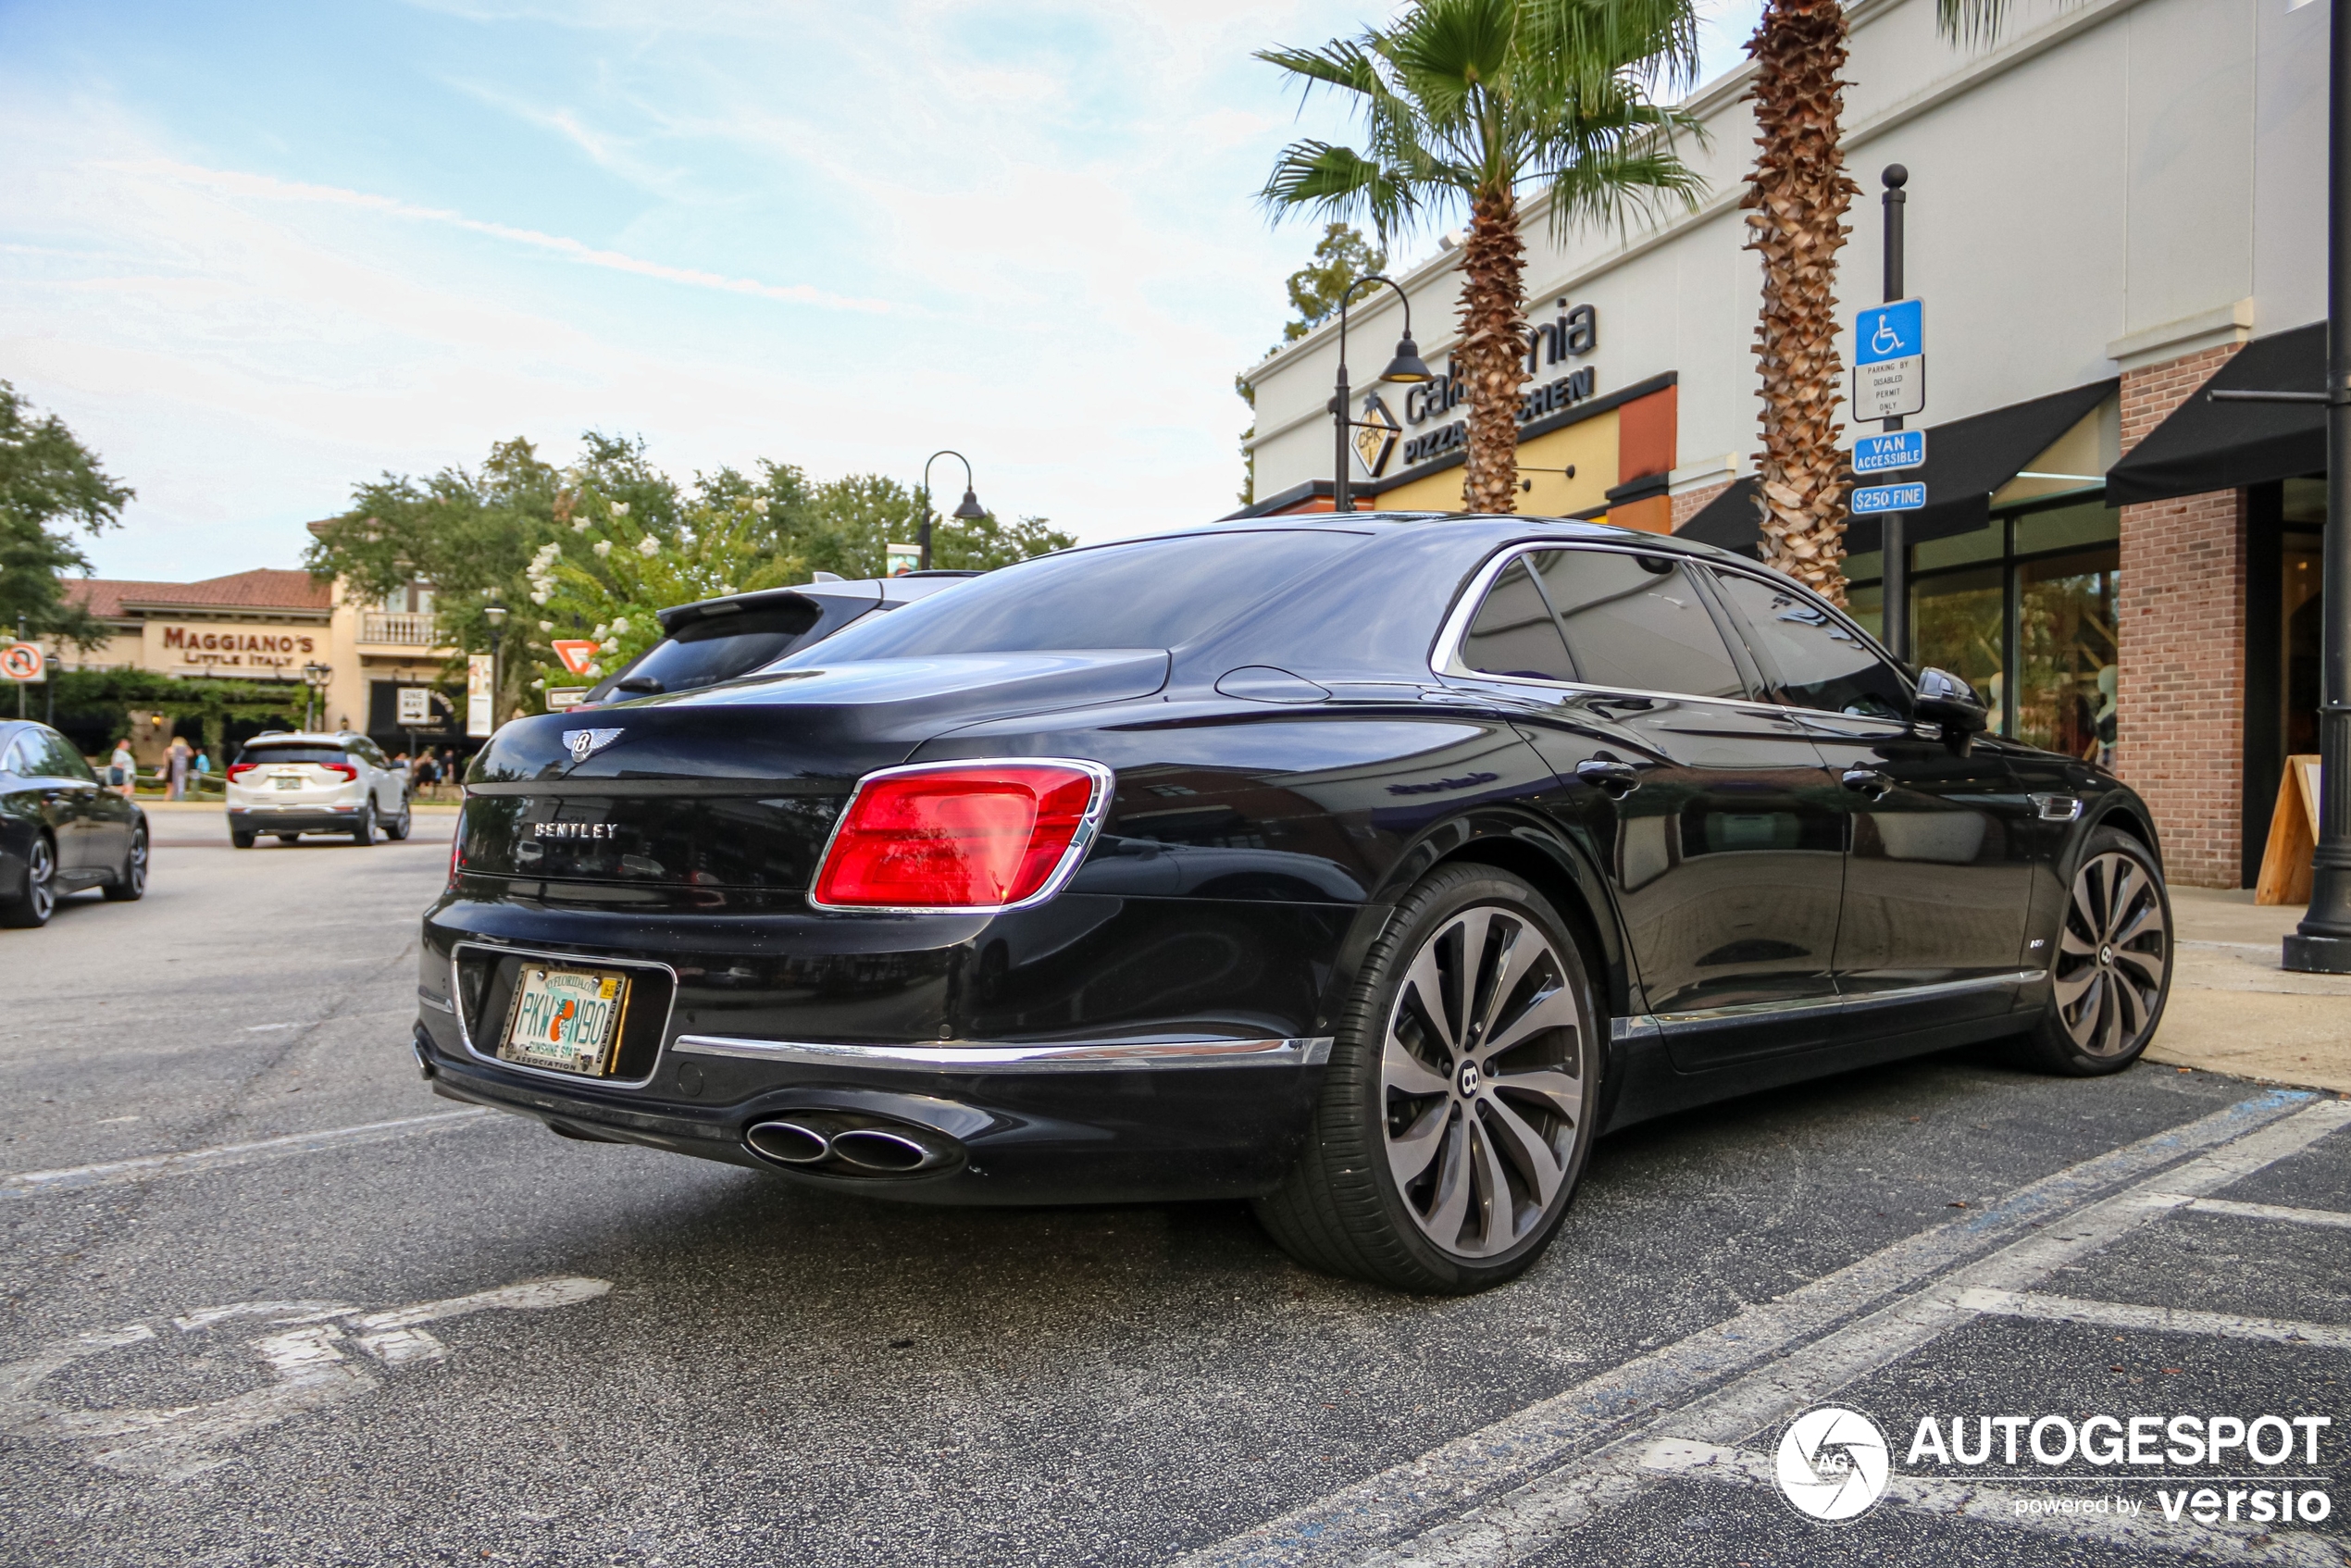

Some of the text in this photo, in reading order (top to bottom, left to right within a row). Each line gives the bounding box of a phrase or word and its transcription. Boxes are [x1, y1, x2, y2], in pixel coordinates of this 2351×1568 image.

[1405, 297, 1596, 425] calinia
[1868, 360, 1909, 374] PARKING BY
[1873, 375, 1902, 386] DISABLED
[1875, 388, 1900, 399] PERMIT
[1879, 402, 1897, 411] ONLY
[1358, 427, 1382, 449] CPK
[1403, 418, 1468, 464] PIZZA
[1872, 435, 1905, 454] VAN
[1857, 449, 1920, 469] ACCESSIBLE
[1856, 488, 1922, 510] $250 FINE
[164, 627, 314, 653] MAGGIANO'S
[184, 653, 293, 667] LITTLE ITALY
[534, 823, 618, 839] BENTLEY
[567, 998, 607, 1045] N90
[516, 1055, 577, 1071] ASSOCIATION
